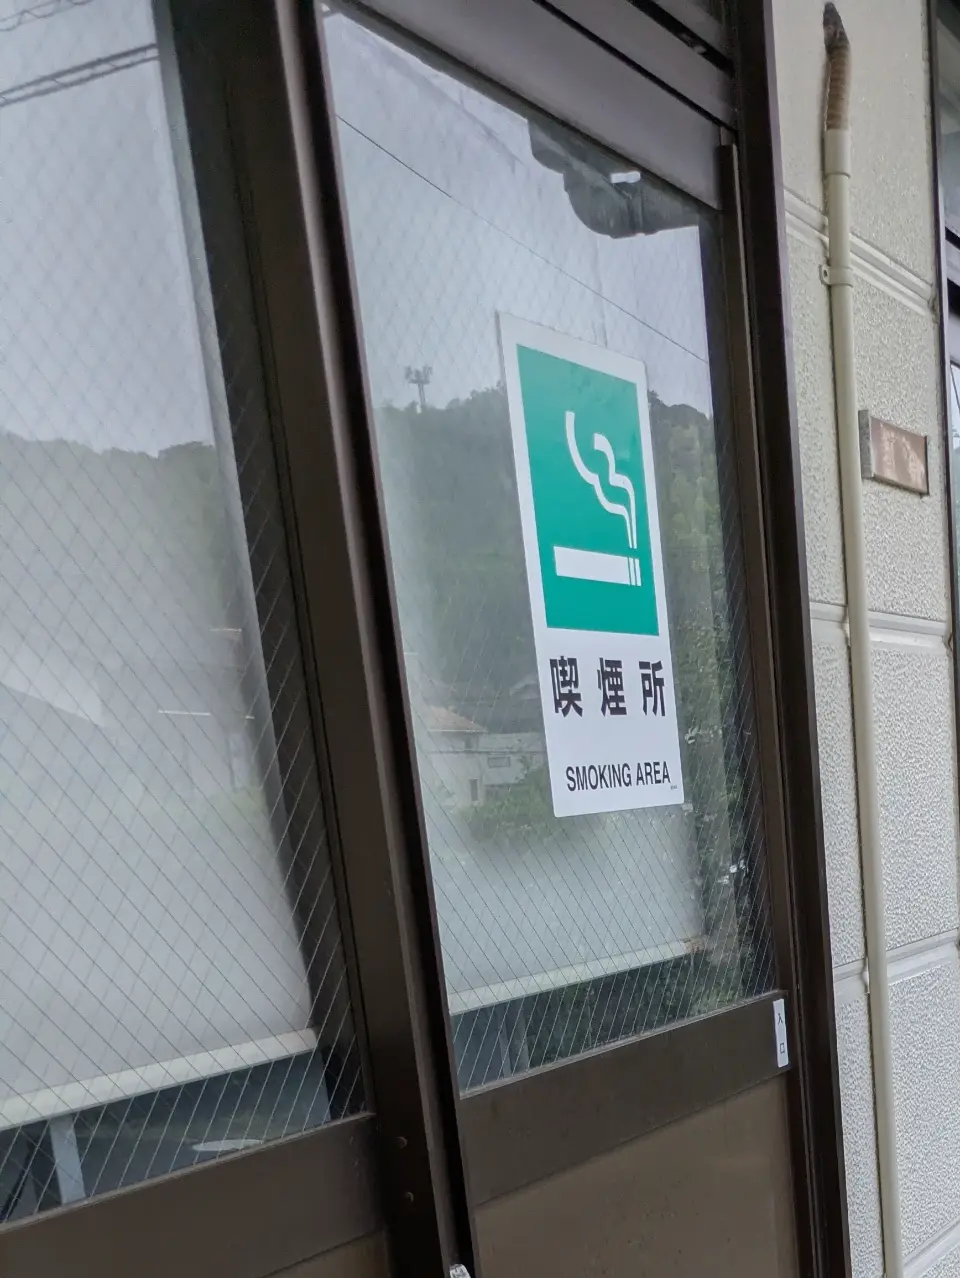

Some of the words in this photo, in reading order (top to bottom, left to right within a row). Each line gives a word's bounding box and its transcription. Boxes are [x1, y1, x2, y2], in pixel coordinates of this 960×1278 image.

[549, 655, 666, 718] 喫煙所
[565, 762, 632, 792] SMOKING
[636, 761, 671, 786] AREA
